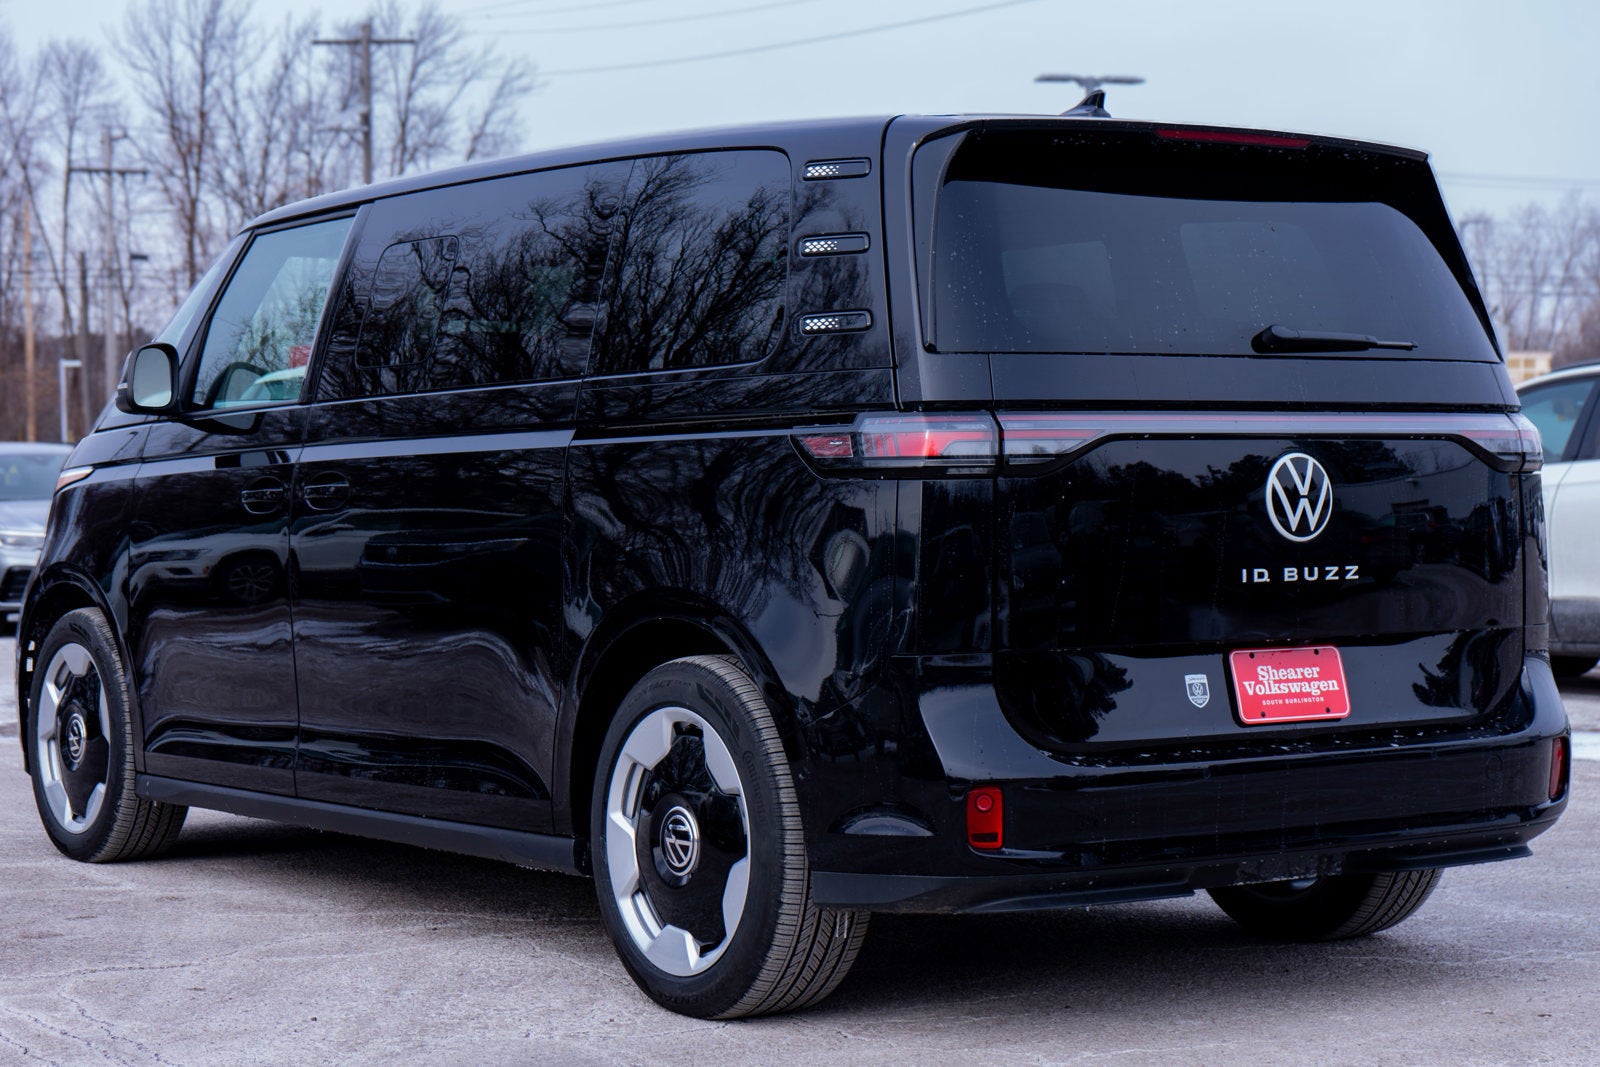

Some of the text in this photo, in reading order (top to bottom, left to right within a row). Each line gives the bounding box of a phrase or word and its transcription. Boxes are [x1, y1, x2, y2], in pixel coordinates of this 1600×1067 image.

[1267, 453, 1332, 540] VW
[1283, 565, 1359, 582] BUZZ
[1257, 665, 1320, 681] Shearer
[1243, 679, 1339, 696] Volkswagen
[1285, 697, 1324, 705] BURLINGTON
